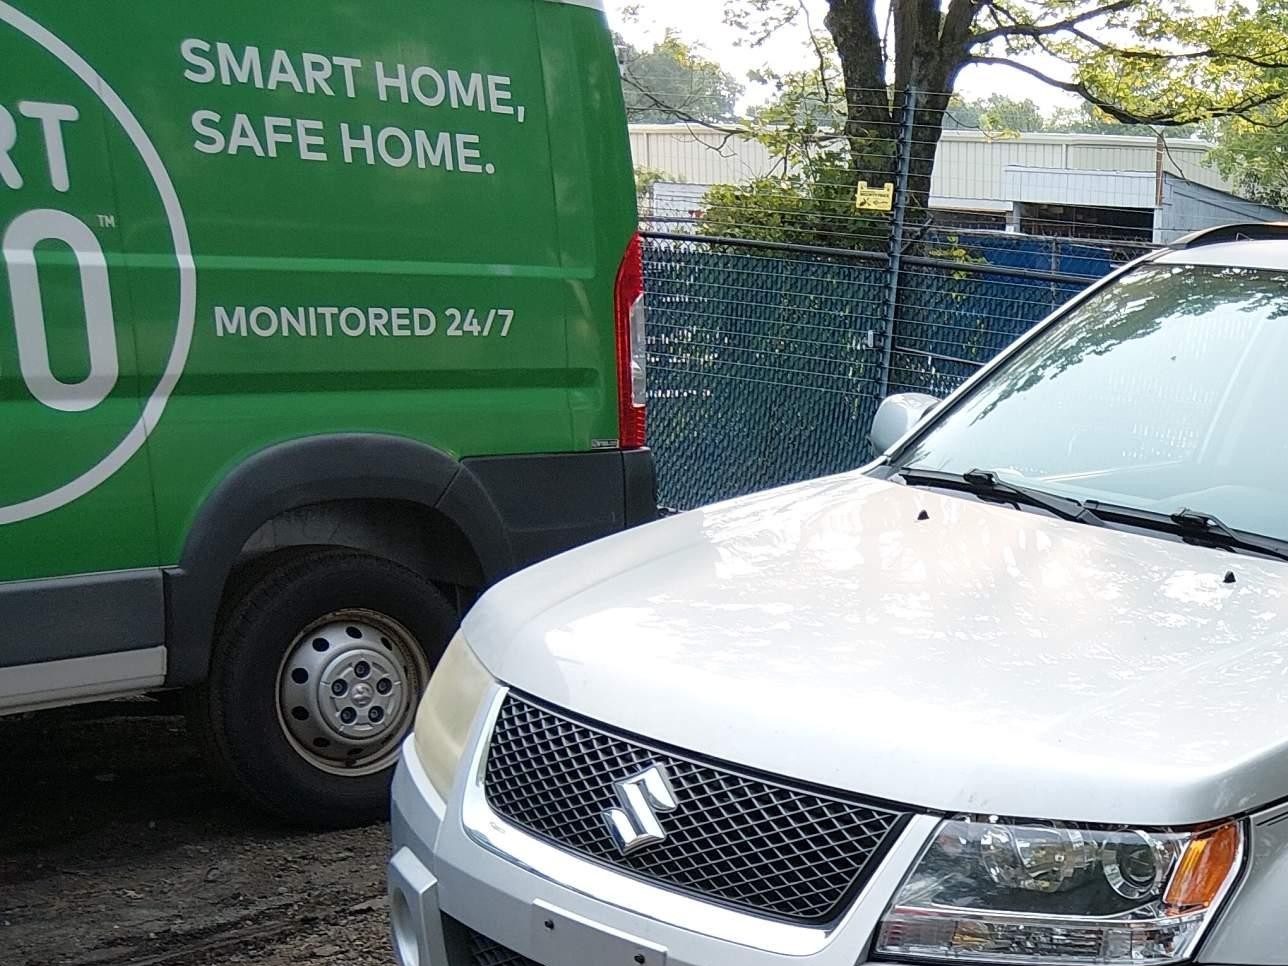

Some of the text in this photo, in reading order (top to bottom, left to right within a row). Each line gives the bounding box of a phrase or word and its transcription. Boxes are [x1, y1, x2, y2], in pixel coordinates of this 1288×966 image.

[180, 38, 526, 123] SMART HOME,
[191, 109, 496, 175] SAFE HOME.
[213, 305, 514, 338] MONITORED 24/7
